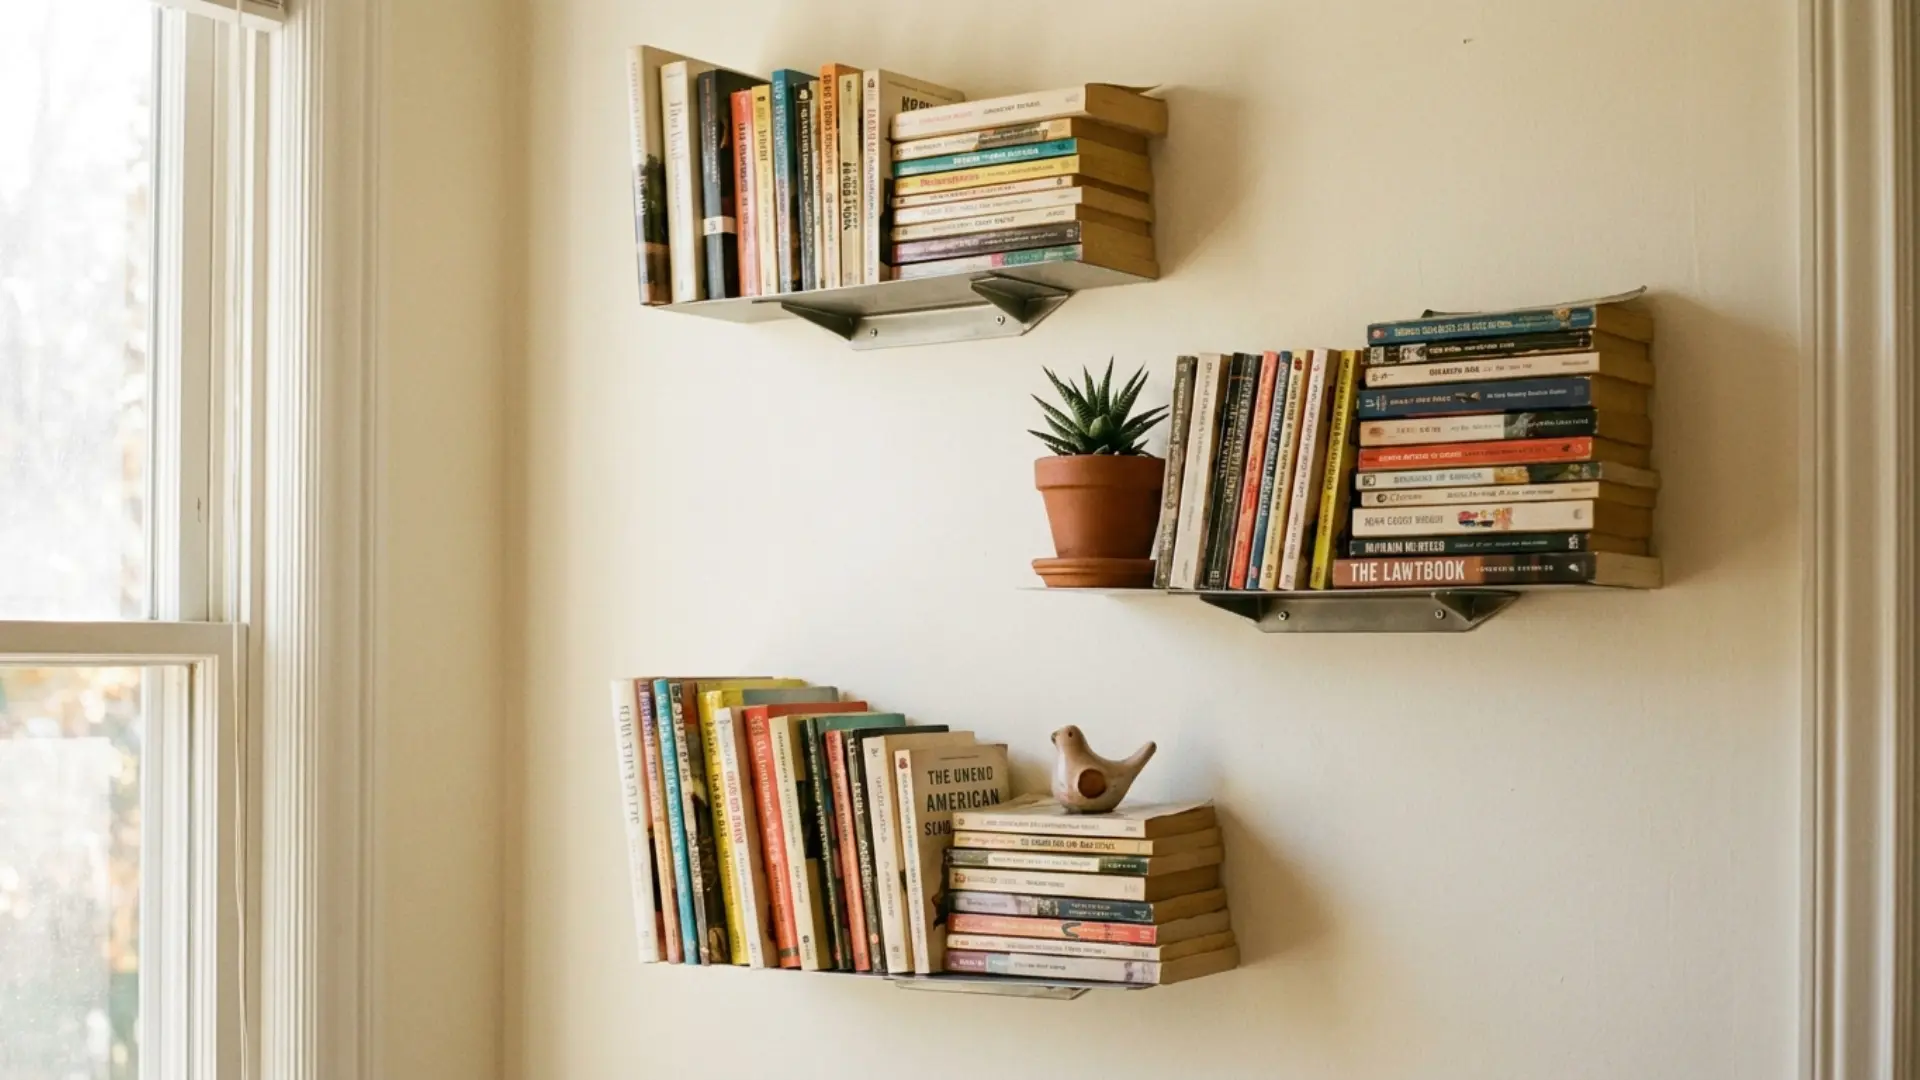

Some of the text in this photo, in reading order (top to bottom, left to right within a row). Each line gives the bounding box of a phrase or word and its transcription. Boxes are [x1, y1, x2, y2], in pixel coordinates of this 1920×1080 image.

[1350, 562, 1378, 582] THE
[1383, 560, 1465, 582] LAWTBOOK
[927, 769, 951, 785] THE
[927, 788, 1000, 812] AMERICAN
